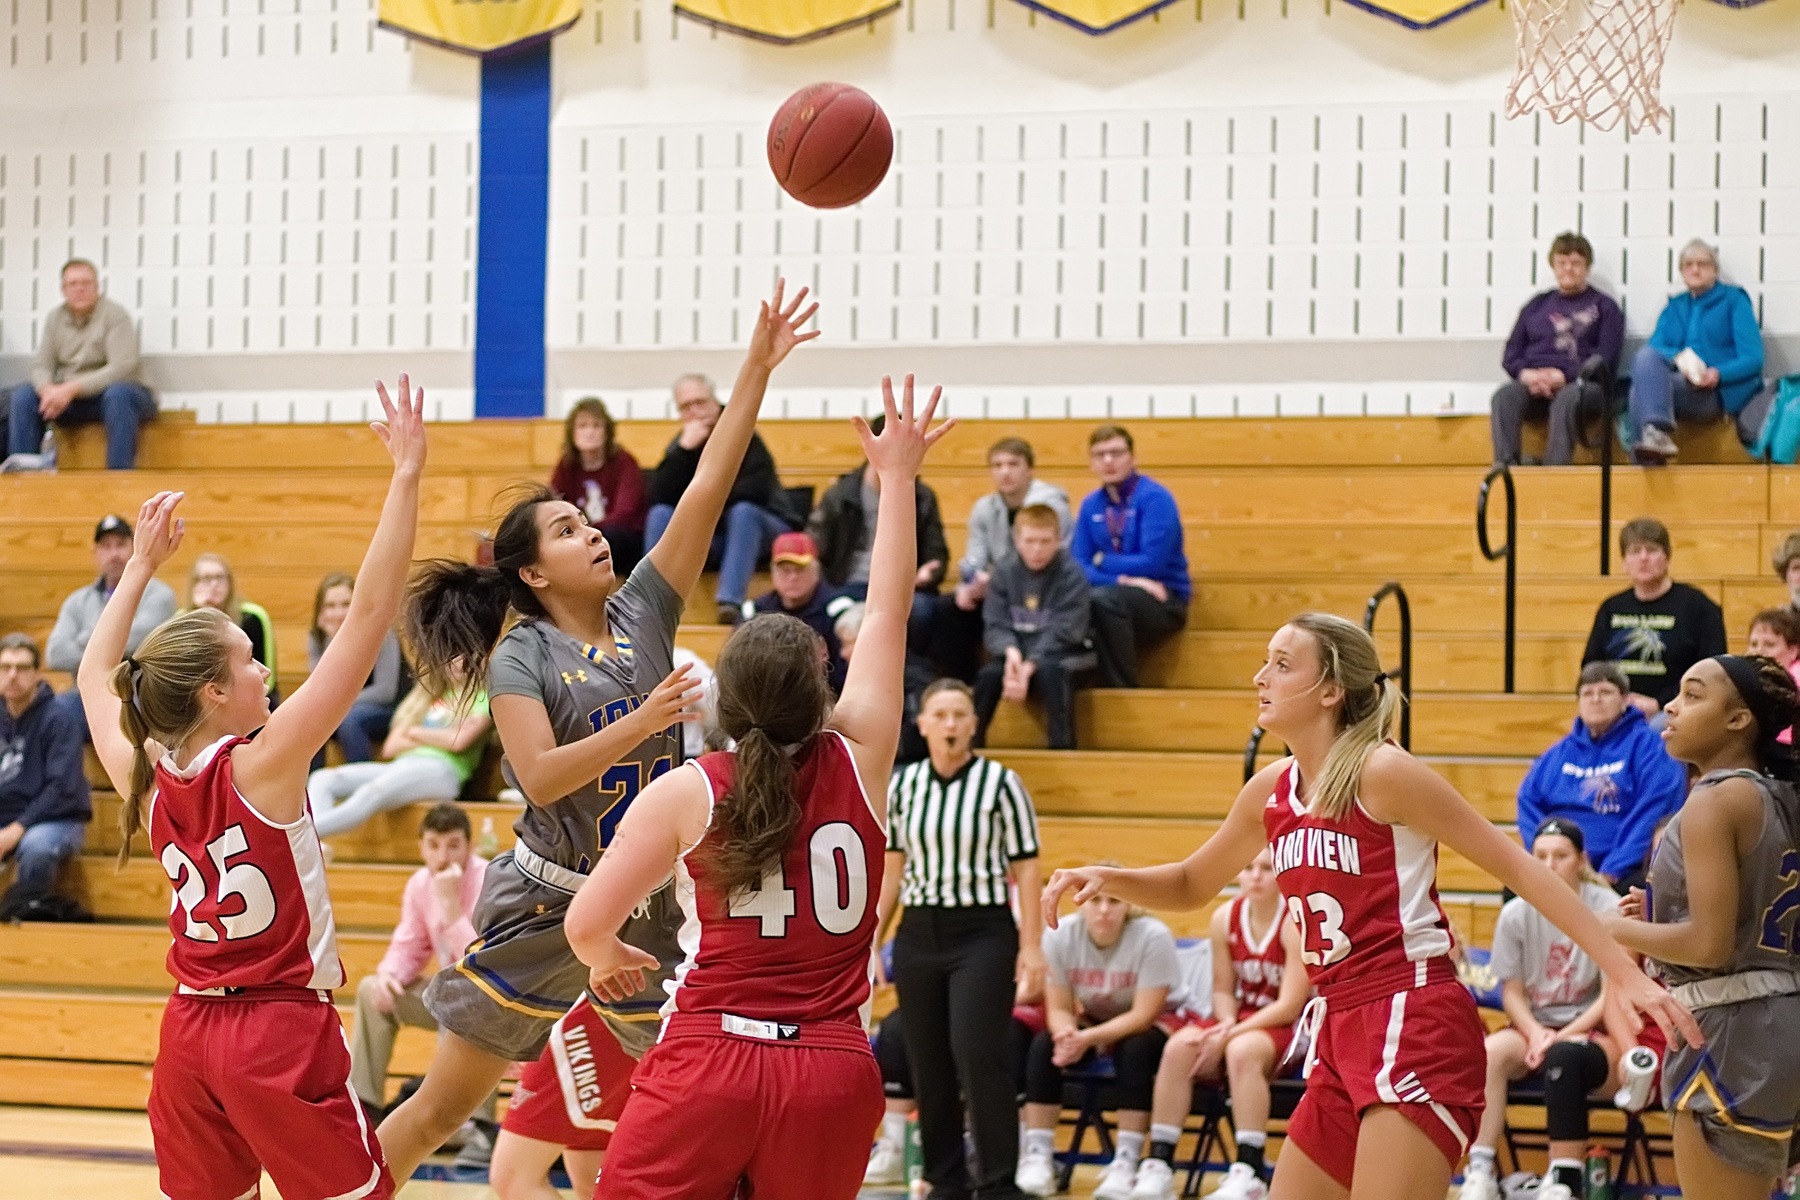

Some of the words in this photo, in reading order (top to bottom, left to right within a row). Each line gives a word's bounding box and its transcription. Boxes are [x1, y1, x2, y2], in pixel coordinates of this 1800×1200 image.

[161, 821, 278, 943] 25
[727, 820, 869, 938] 40
[1269, 829, 1306, 879] AND
[1306, 826, 1362, 876] VIEW
[1287, 891, 1352, 967] 23
[563, 1024, 603, 1113] VIKINGS
